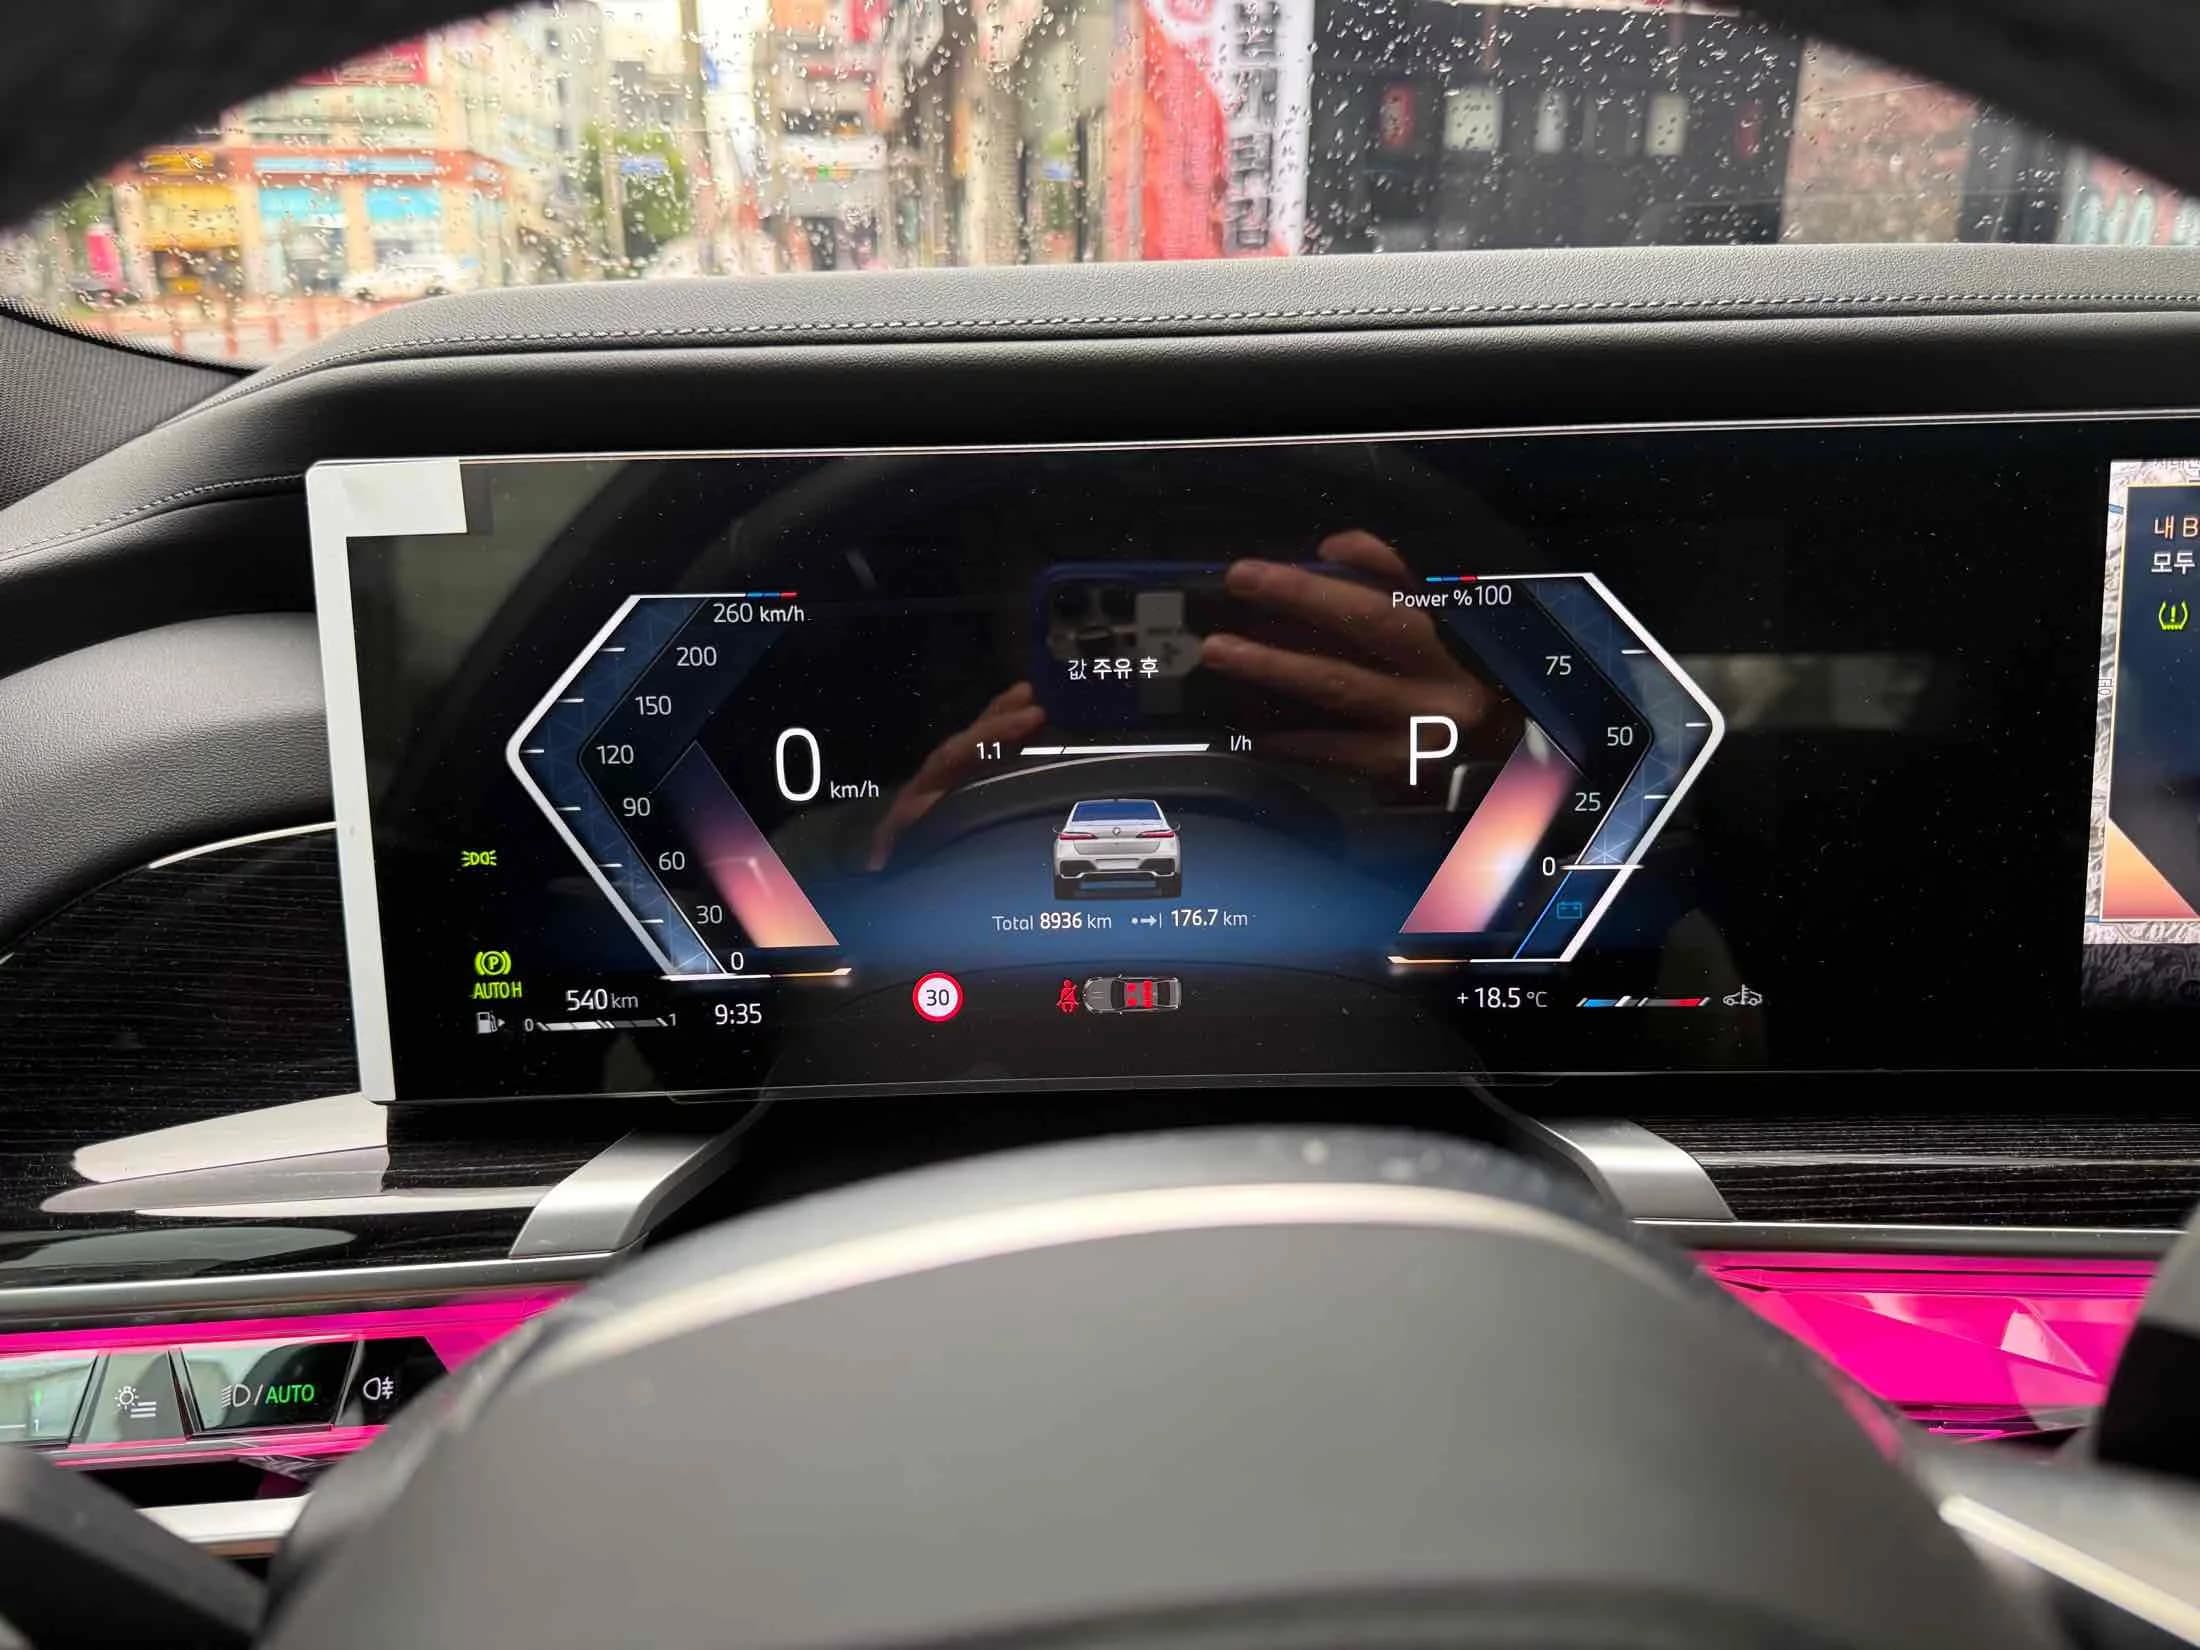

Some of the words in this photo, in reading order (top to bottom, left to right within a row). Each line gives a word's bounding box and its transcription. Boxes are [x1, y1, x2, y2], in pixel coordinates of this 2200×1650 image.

[2154, 515, 2175, 540] 내
[2151, 551, 2196, 575] 모두
[1392, 591, 1449, 609] Power
[712, 602, 753, 623] 260
[759, 604, 805, 623] km/h
[676, 646, 717, 667] 200
[1545, 655, 1572, 676] 75
[1067, 658, 1088, 681] 값
[1092, 657, 1133, 680] 주유
[1139, 655, 1160, 679] 후
[634, 695, 672, 716] 150
[1607, 726, 1633, 747] 50
[596, 744, 634, 765] 120
[976, 741, 1001, 760] 1.1
[1230, 735, 1252, 752] l/h
[1409, 715, 1460, 787] P
[775, 727, 821, 802] 0
[830, 779, 880, 799] km/h
[623, 797, 651, 817] 90
[1574, 791, 1601, 812] 25
[658, 850, 686, 871] 60
[1542, 856, 1556, 877] 0
[695, 904, 723, 925] 30
[991, 914, 1034, 931] Total
[1040, 911, 1083, 930] 8936
[1087, 913, 1112, 929] km
[1170, 908, 1219, 928] 176.7
[1223, 910, 1248, 927] km
[730, 951, 744, 971] 0
[566, 988, 608, 1011] 540
[610, 992, 639, 1009] km
[926, 988, 950, 1007] 30
[523, 1017, 535, 1033] 0
[667, 1012, 678, 1027] 1
[714, 1002, 762, 1025] 9:35
